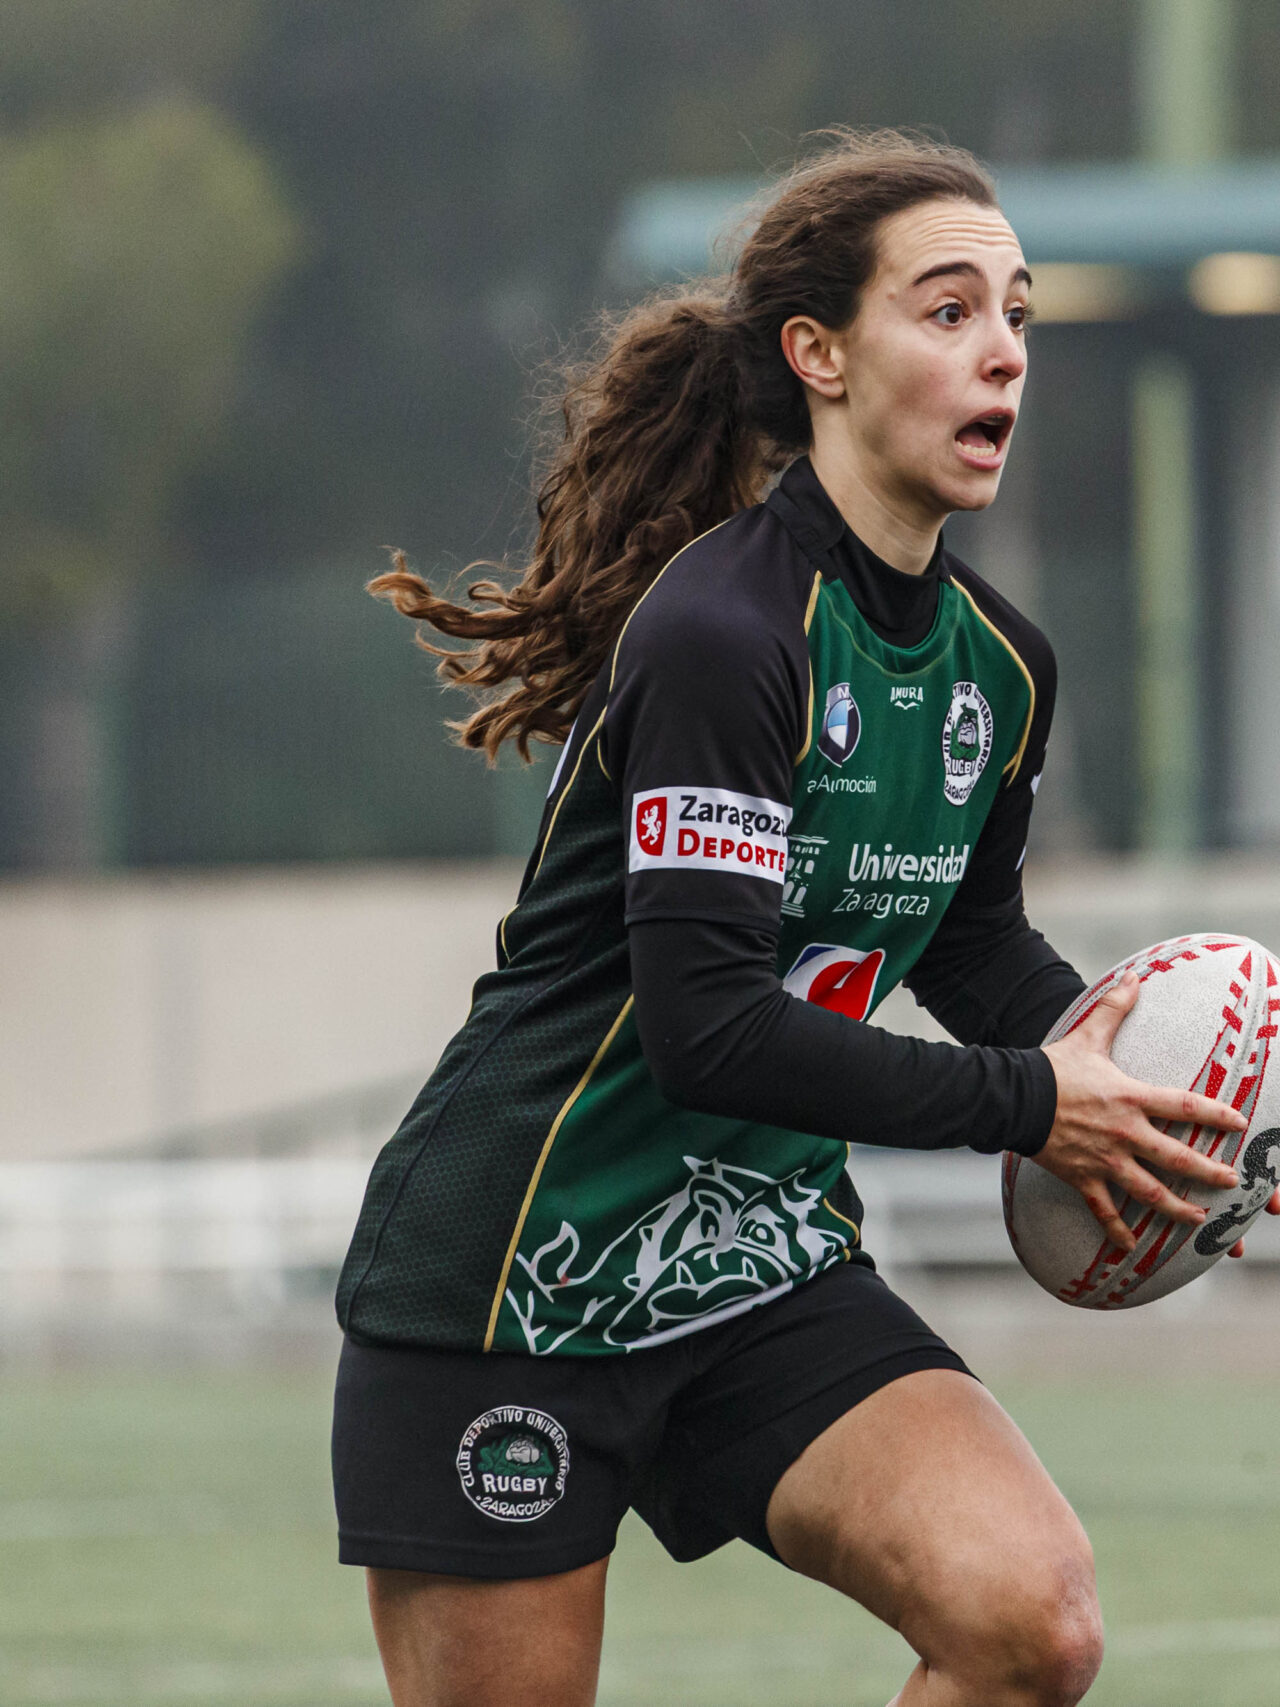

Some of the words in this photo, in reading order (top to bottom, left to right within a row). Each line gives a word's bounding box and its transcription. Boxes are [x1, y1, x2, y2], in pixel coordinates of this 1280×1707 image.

[890, 686, 924, 703] AMURA
[677, 828, 786, 872] DEPORTE
[848, 843, 970, 884] Universidad
[832, 888, 930, 919] Zaragoza
[464, 1409, 524, 1448] DEPORTIVO
[458, 1451, 475, 1487] CLUB
[526, 1412, 568, 1491] UNIVERSITARIO
[482, 1473, 548, 1495] RUGBY
